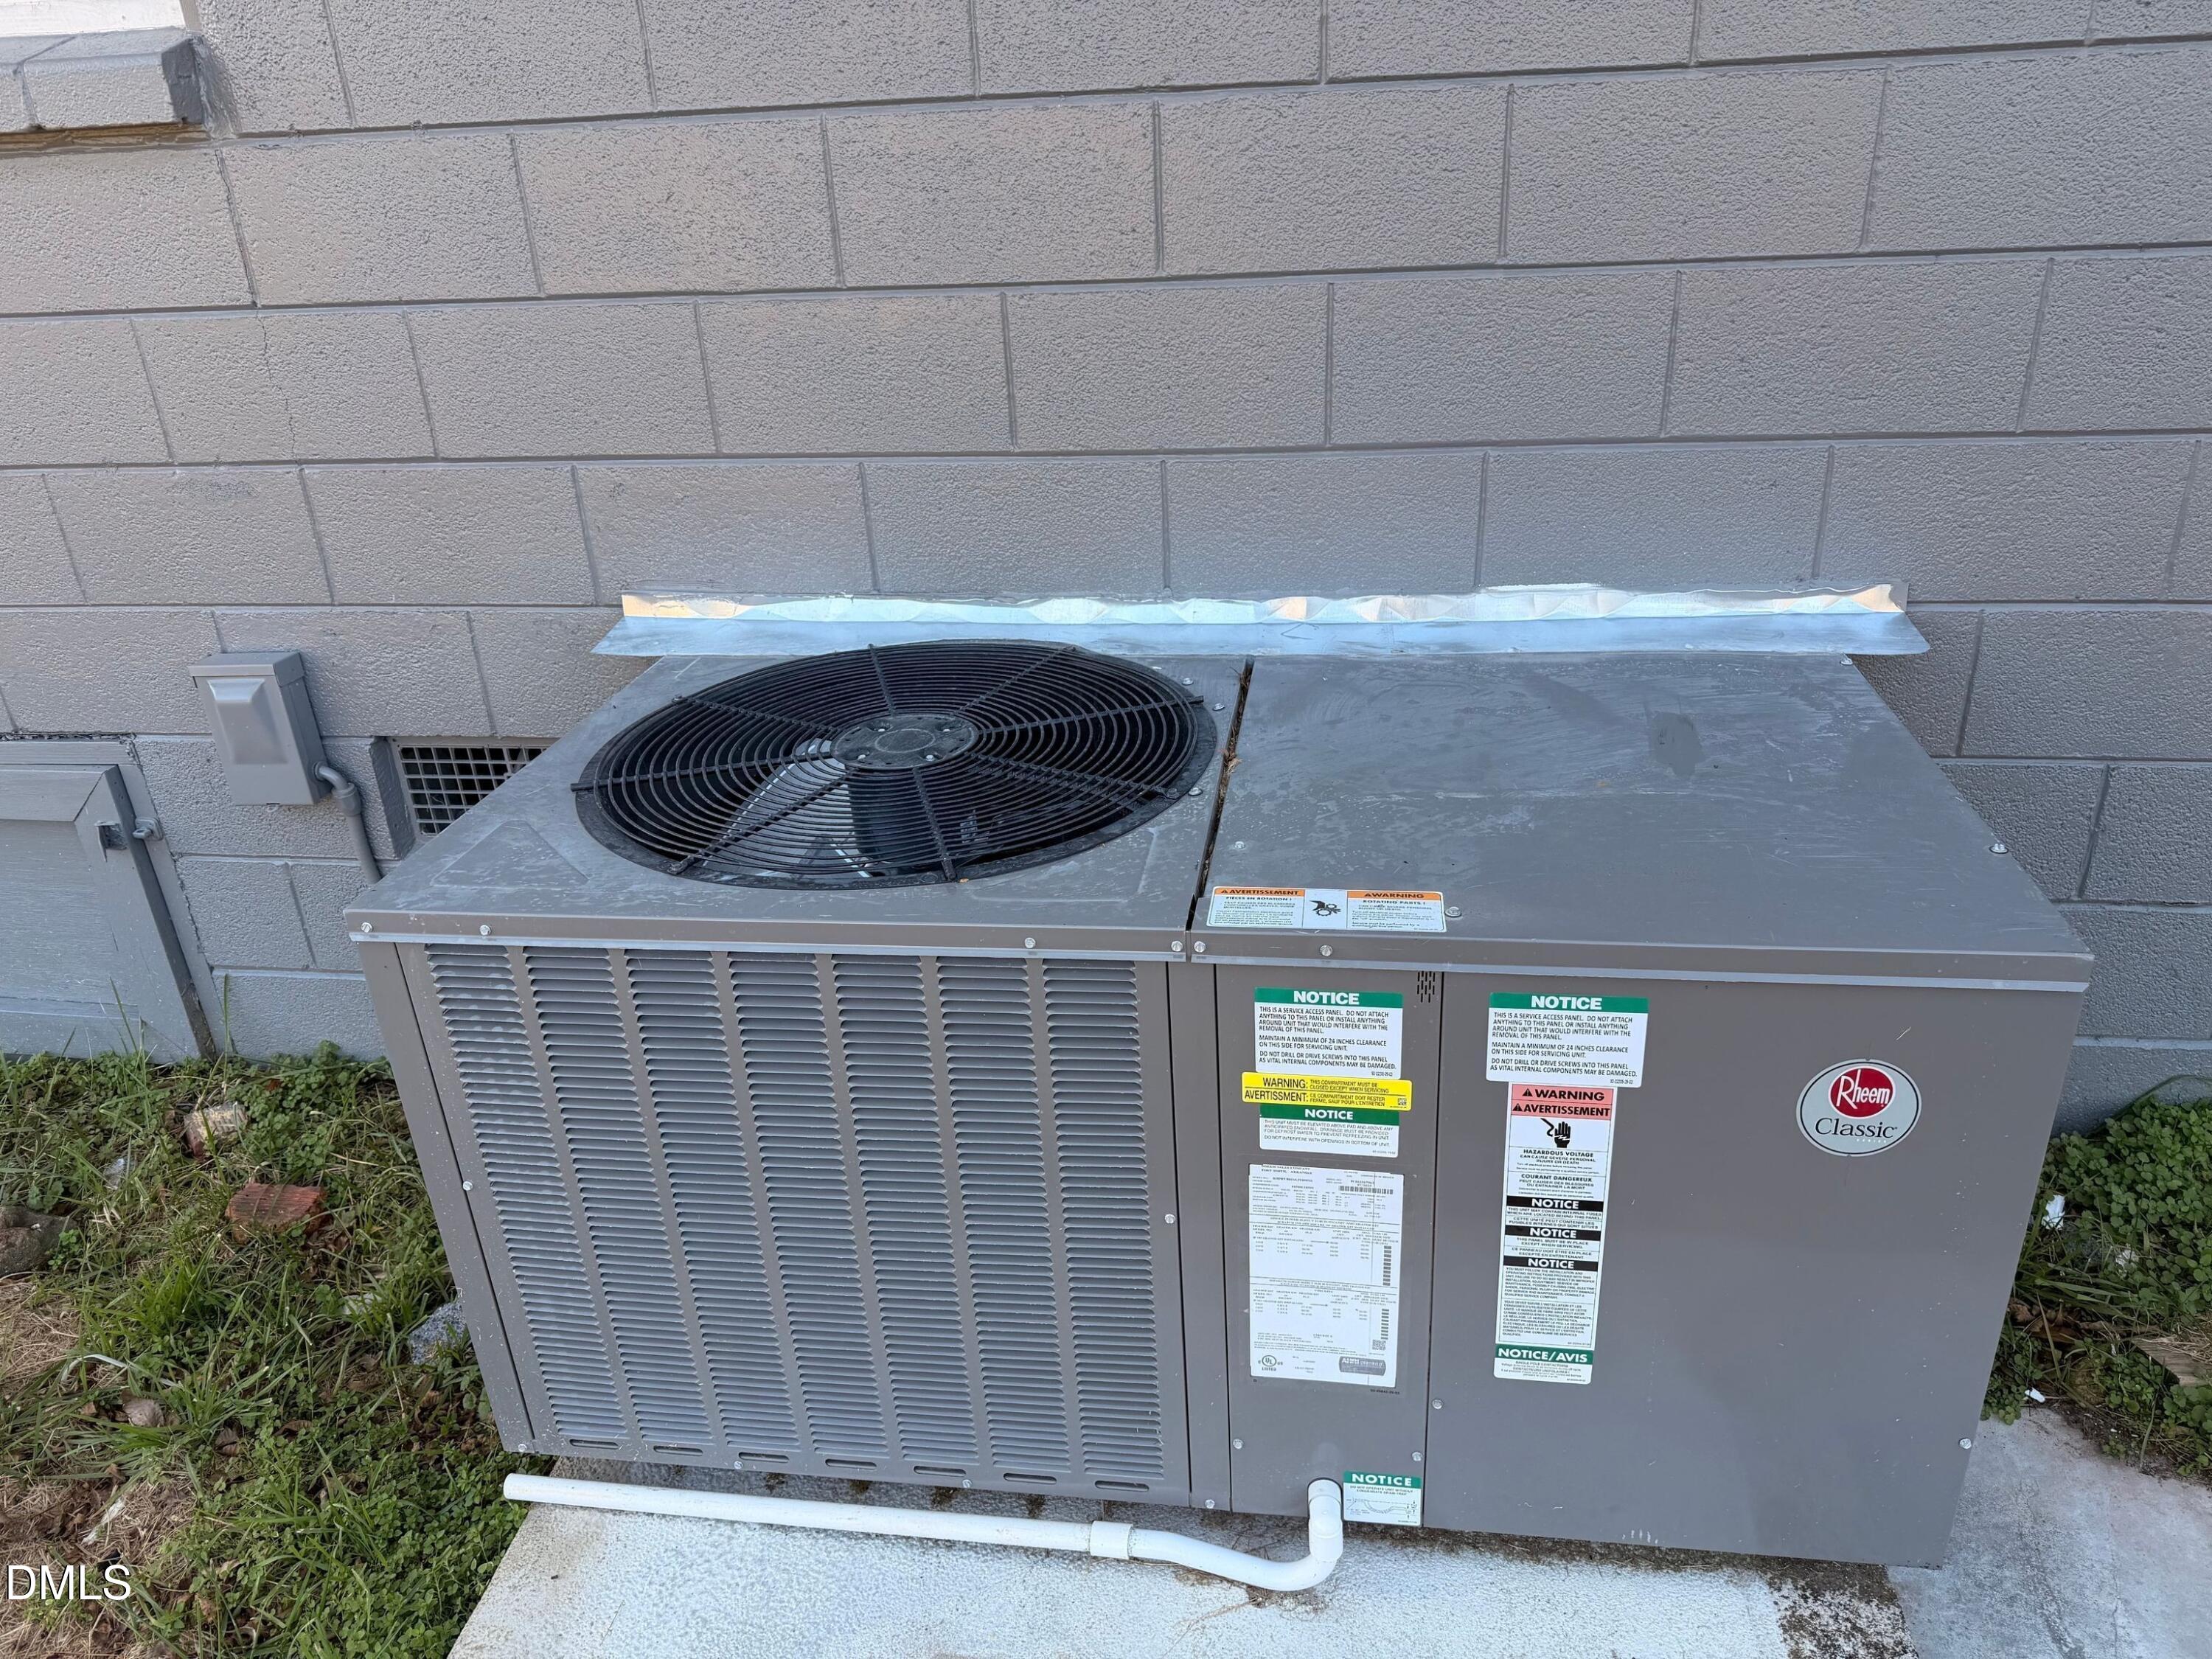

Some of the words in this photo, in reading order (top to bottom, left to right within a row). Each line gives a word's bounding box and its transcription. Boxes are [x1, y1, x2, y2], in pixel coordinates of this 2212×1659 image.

[1293, 990, 1360, 1005] NOTICE
[1531, 995, 1603, 1010] NOTICE
[1543, 1067, 1582, 1075] COMPONENTS
[1263, 1077, 1308, 1089] WARNING:
[1835, 1068, 1891, 1109] Rheem
[1245, 1089, 1309, 1102] AVERTISSMENT:
[1534, 1088, 1605, 1101] WARNING
[1304, 1108, 1354, 1120] NOTICE
[1523, 1104, 1611, 1116] AVERTISSEMENT
[1815, 1117, 1894, 1138] Classic
[1531, 1198, 1579, 1209] NOTICE
[1529, 1228, 1577, 1239] NOTICE
[1528, 1258, 1575, 1269] NOTICE
[1498, 1348, 1587, 1363] NOTICE/AVIS
[1352, 1473, 1412, 1486] NOTICE
